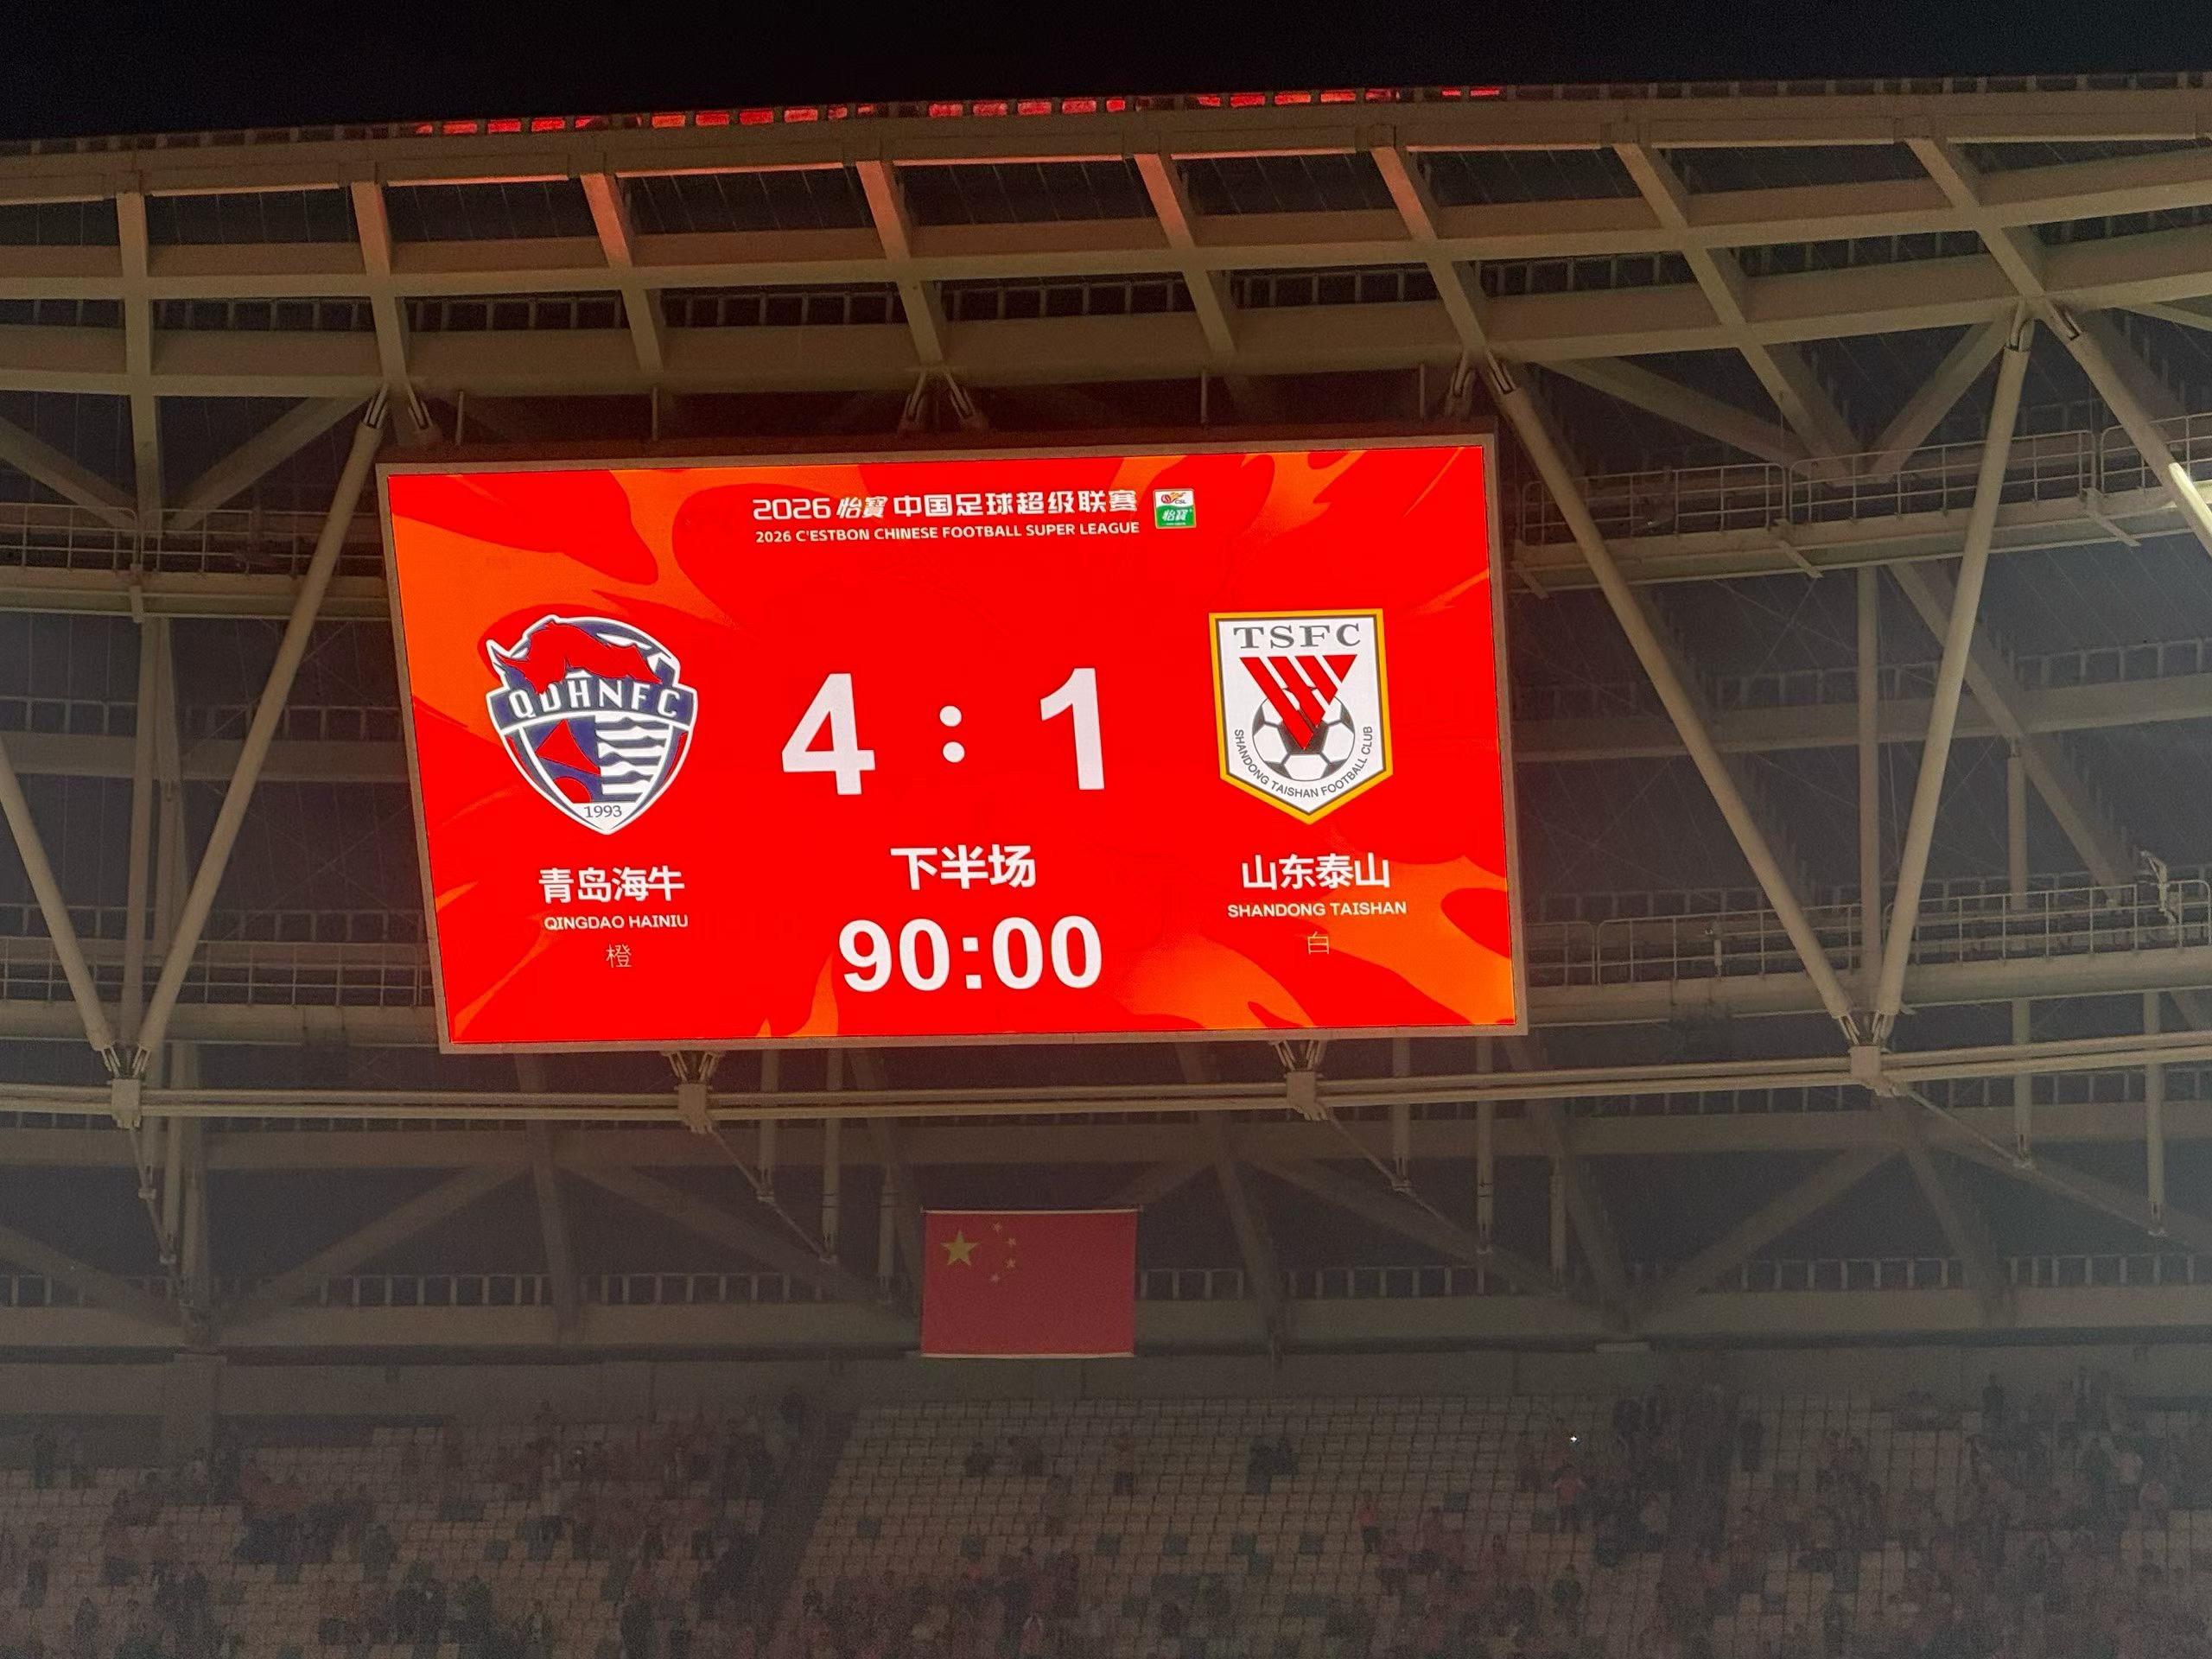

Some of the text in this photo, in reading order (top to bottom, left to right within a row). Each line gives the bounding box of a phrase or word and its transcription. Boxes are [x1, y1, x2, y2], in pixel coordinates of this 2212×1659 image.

[753, 498, 831, 520] 2026
[893, 490, 1137, 518] 中国足球超级联赛
[755, 521, 1140, 543] 2026 C'ESTBON CHINESE FOOTBALL SUPER LEAGUE
[1233, 623, 1361, 649] TSFC
[508, 679, 681, 719] QDHNFC
[781, 672, 875, 795] 4
[1040, 668, 1105, 790] 1
[1234, 726, 1374, 798] SHANDONG TAISHAN FOOTBALL CLUB
[583, 805, 623, 818] 1993
[890, 844, 1036, 890] 下半场
[1242, 852, 1391, 890] 山东泰山
[538, 866, 685, 904] 青岛海牛
[544, 914, 689, 931] QINGDAO HAINIU
[1227, 901, 1408, 918] SHANDONG TAISHAN
[606, 944, 632, 969] 橙
[838, 916, 1103, 993] 90:00
[1307, 931, 1330, 955] 白
